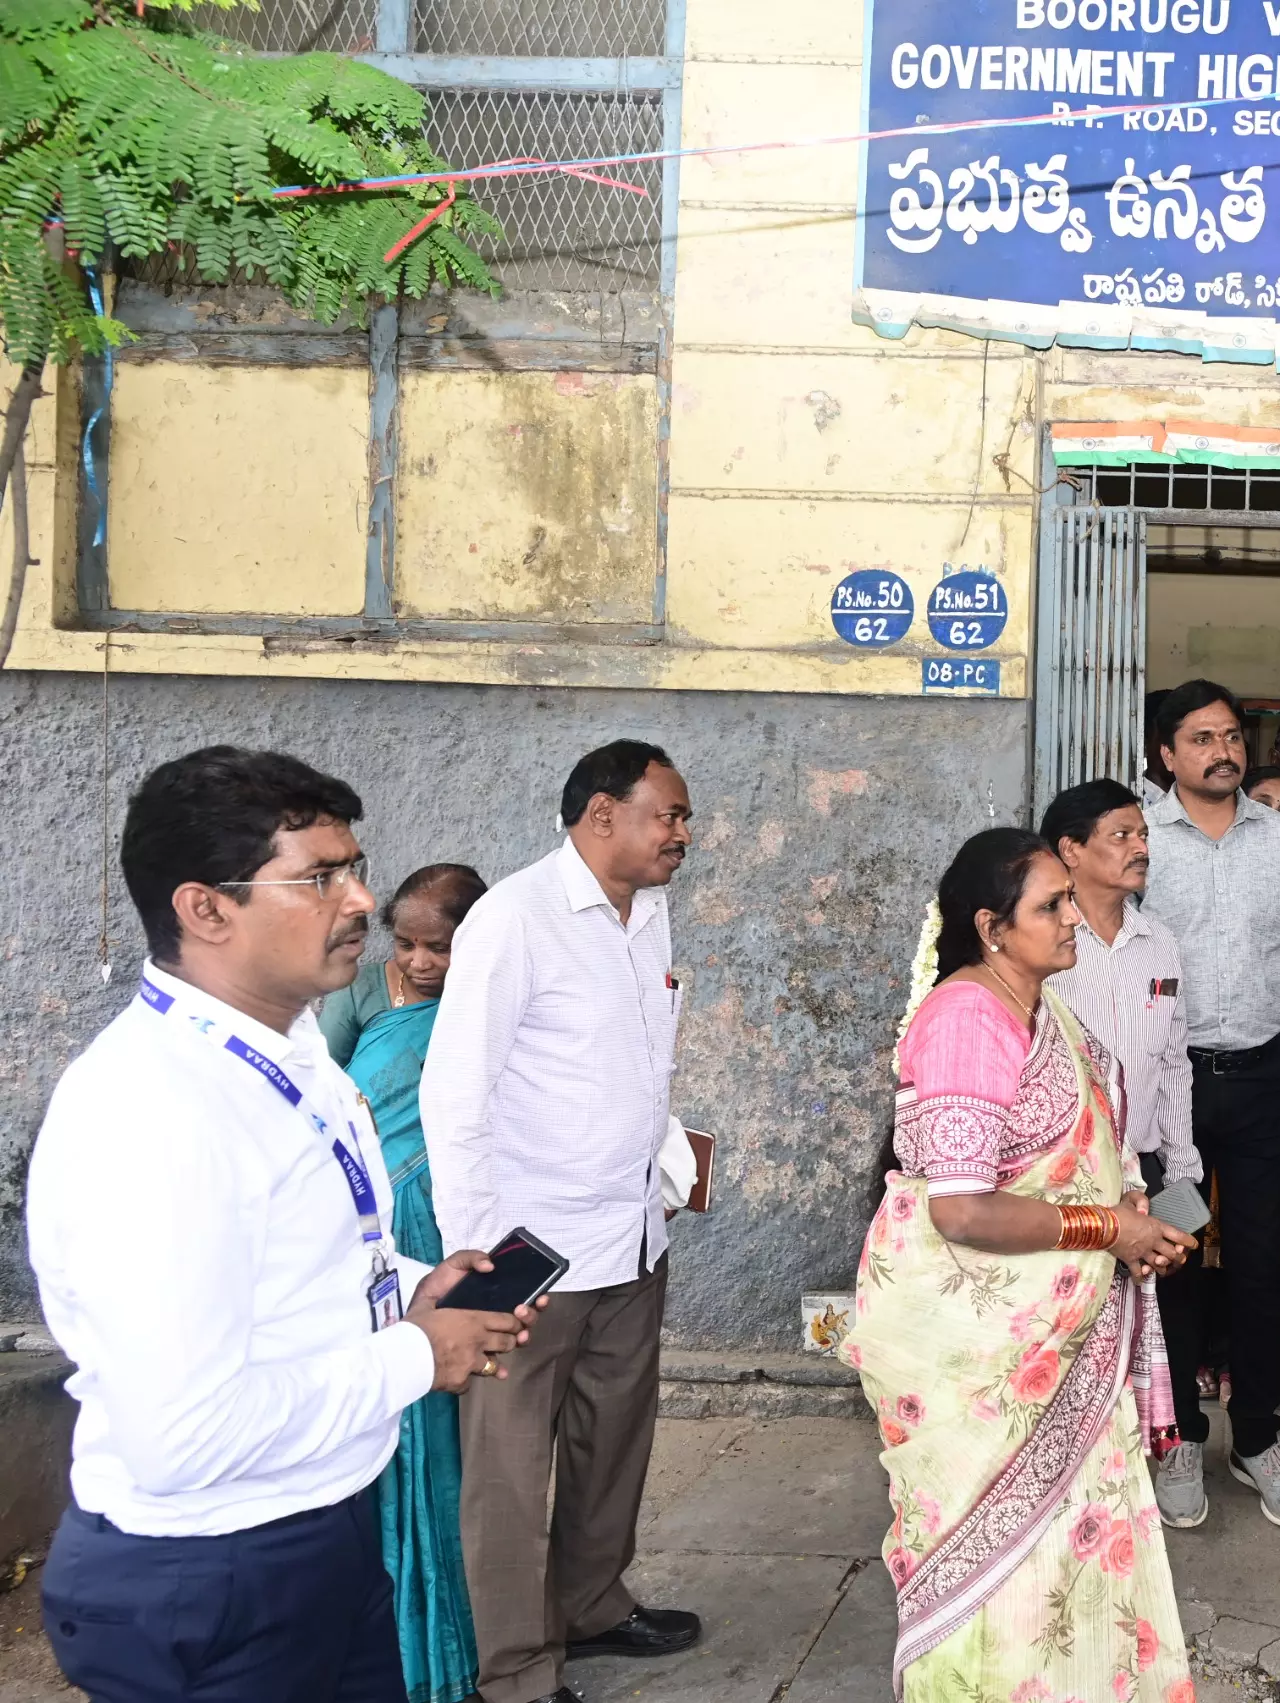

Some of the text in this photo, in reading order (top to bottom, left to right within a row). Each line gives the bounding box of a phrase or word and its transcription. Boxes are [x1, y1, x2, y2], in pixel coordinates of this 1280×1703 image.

[1016, 0, 1230, 34] BOORUGU
[891, 43, 1175, 98] GOVERNMENT
[1123, 107, 1217, 136] ROAD,
[886, 147, 1094, 254] ప్రభుత్వ
[1105, 157, 1265, 254] ఉన్నత
[854, 617, 890, 642] 62
[949, 621, 985, 645] 62
[245, 1048, 290, 1091] HYDRAA
[342, 1153, 367, 1197] HYDRAA
